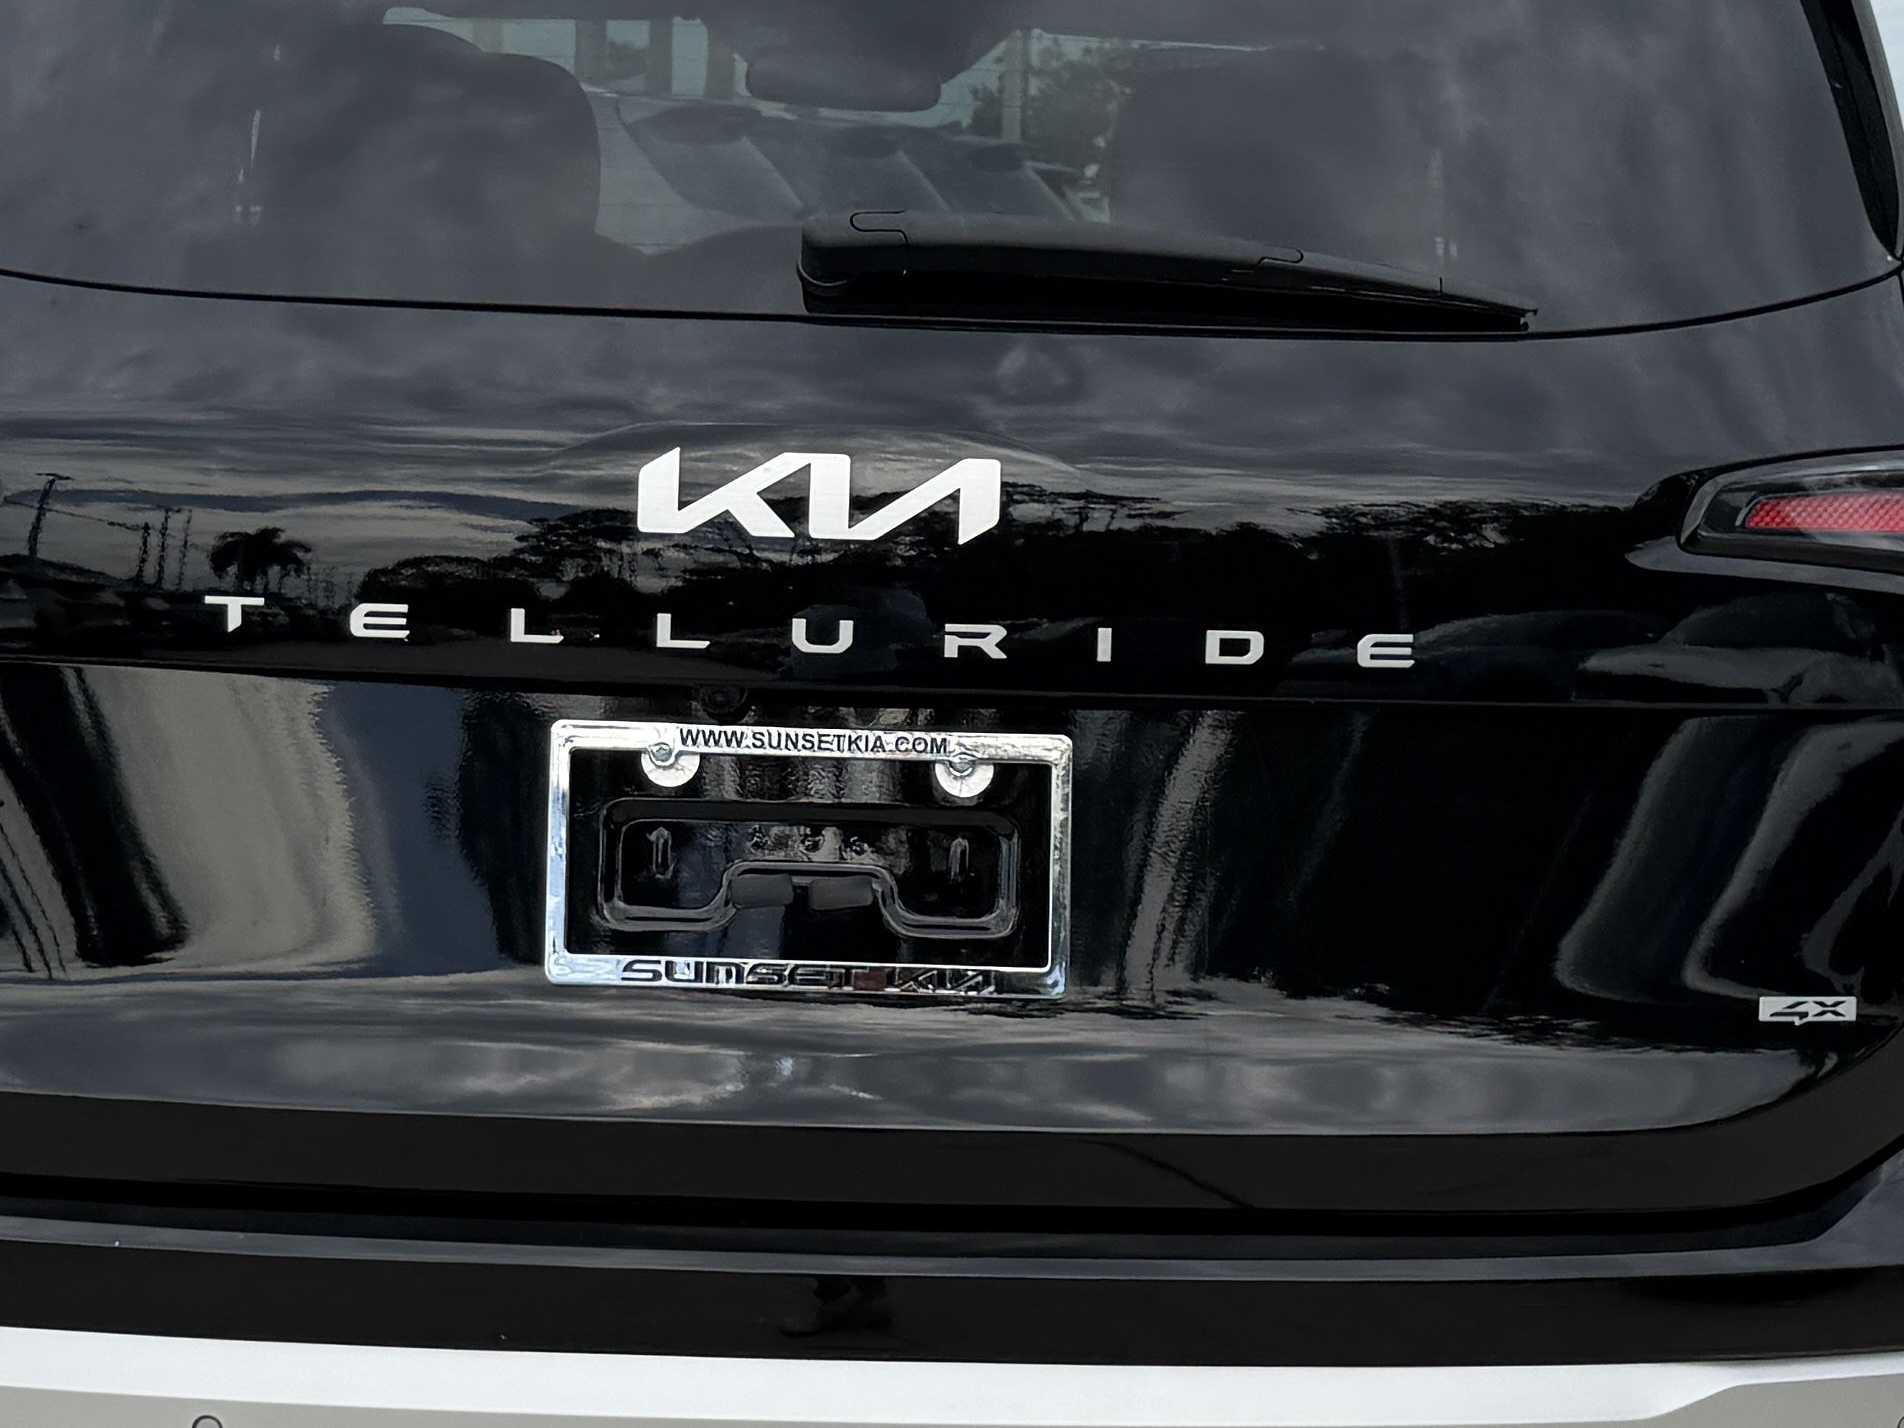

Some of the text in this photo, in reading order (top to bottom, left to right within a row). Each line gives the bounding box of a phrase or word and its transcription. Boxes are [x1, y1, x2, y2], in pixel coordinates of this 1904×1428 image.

[638, 447, 1001, 545] KIA
[204, 595, 1416, 669] TELLURIDE
[679, 727, 948, 756] WWW.SUNSETKIA.COM
[621, 959, 847, 990] SUNSET
